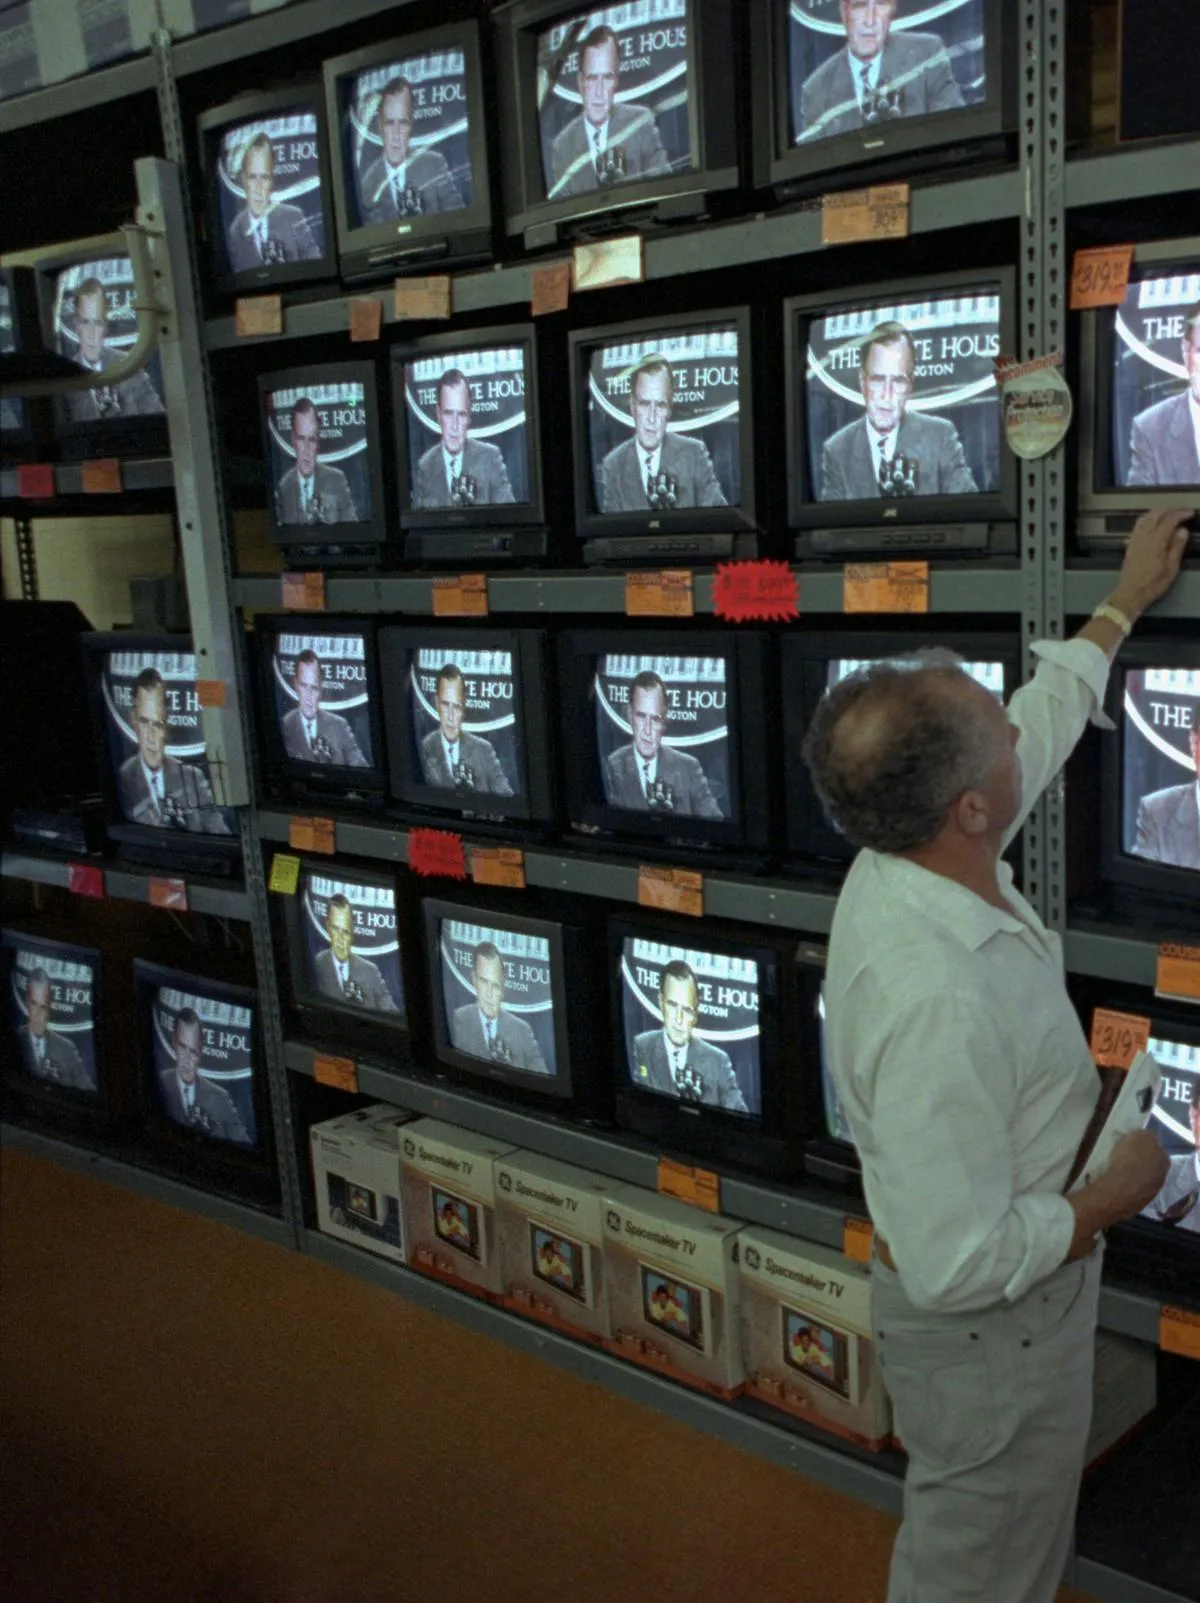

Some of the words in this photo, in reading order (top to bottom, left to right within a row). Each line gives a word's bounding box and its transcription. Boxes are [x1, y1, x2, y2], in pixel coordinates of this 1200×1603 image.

[640, 29, 687, 52] HOUS
[1143, 316, 1184, 340] THE
[829, 346, 861, 370] THE
[941, 334, 1000, 358] HOUS
[605, 376, 631, 395] THE
[696, 365, 740, 388] HOUS
[417, 387, 437, 405] THE
[336, 665, 364, 681] HOU
[421, 676, 437, 693] THE
[481, 682, 514, 699] HOU
[608, 683, 629, 703] THE
[686, 691, 727, 709] HOU
[1150, 703, 1193, 729] THE
[367, 913, 396, 929] HOU
[454, 949, 473, 968] THE
[520, 966, 550, 985] HOU
[635, 967, 660, 987] THE
[1164, 1077, 1193, 1102] HE
[461, 1160, 473, 1175] TV
[564, 1197, 580, 1212] TV
[625, 1219, 681, 1250] Spacemaker
[681, 1239, 697, 1256] TV
[764, 1256, 828, 1292] Spacemaker
[827, 1280, 845, 1299] TV
